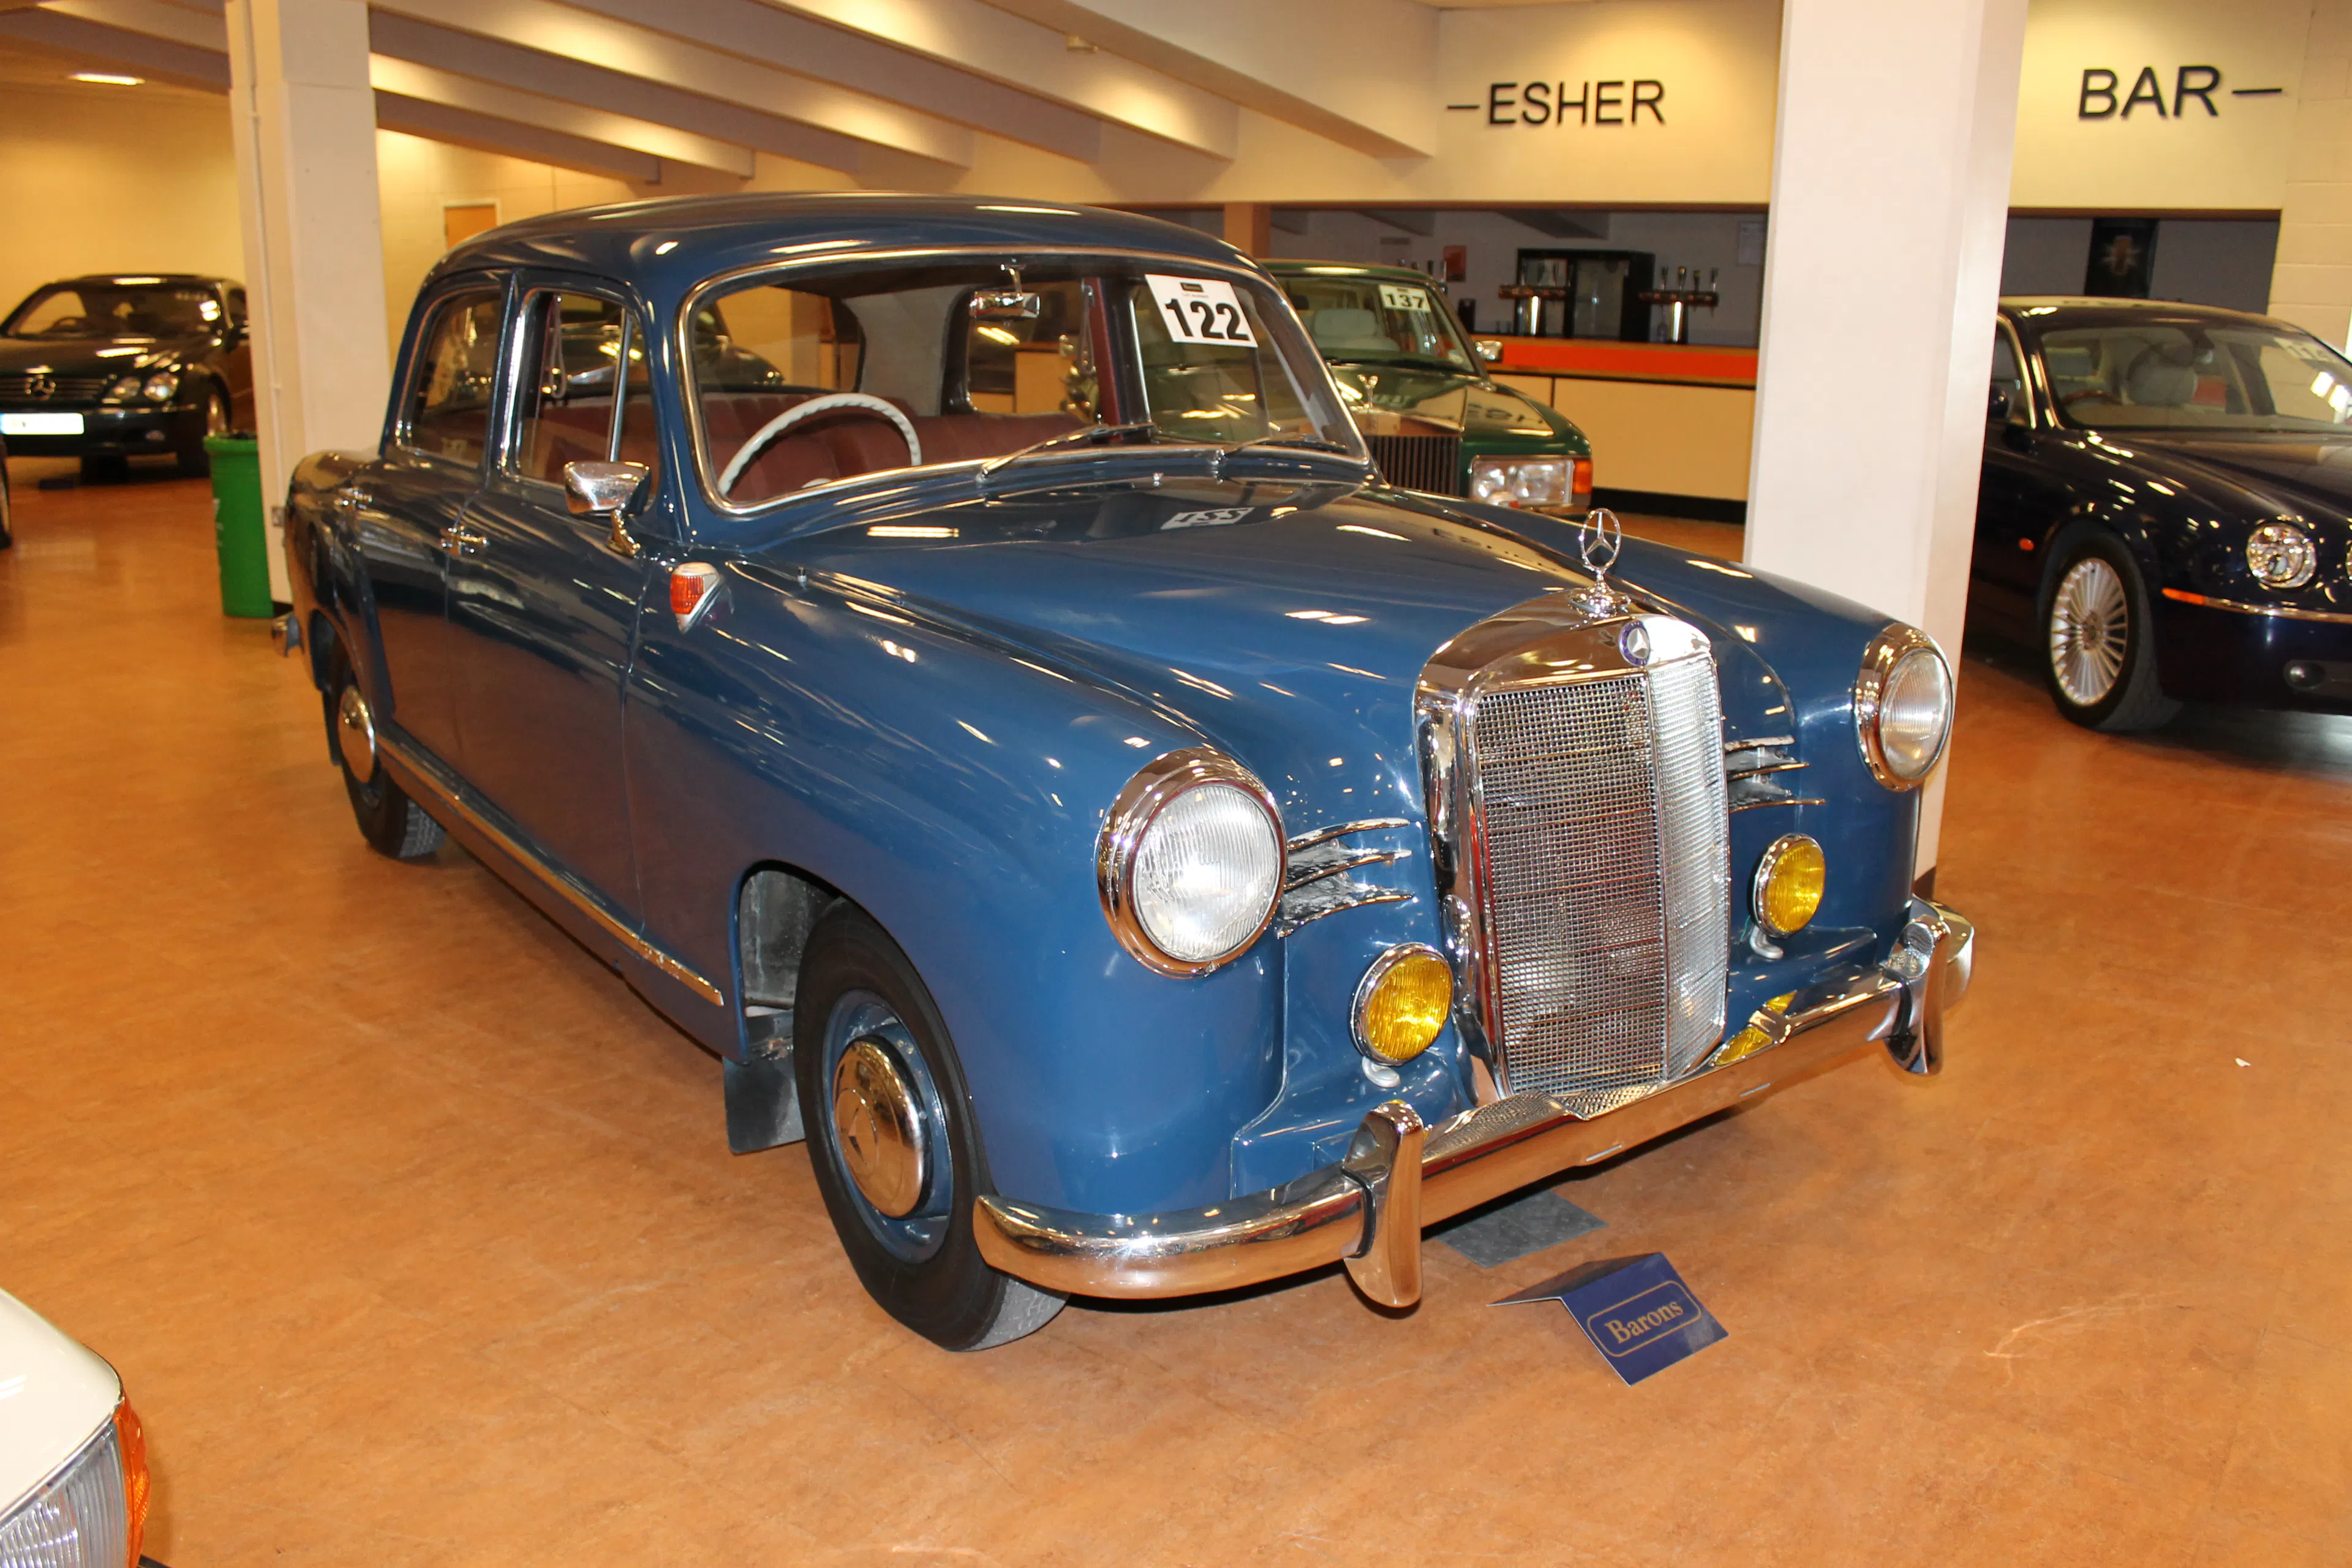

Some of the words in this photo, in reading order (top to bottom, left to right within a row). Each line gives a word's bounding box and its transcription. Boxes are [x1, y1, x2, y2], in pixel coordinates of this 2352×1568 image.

[1489, 79, 1666, 125] ESHER
[2079, 66, 2222, 118] BAR
[1164, 297, 1250, 342] 122
[1385, 293, 1424, 309] 137
[1604, 1301, 1684, 1344] Barons
